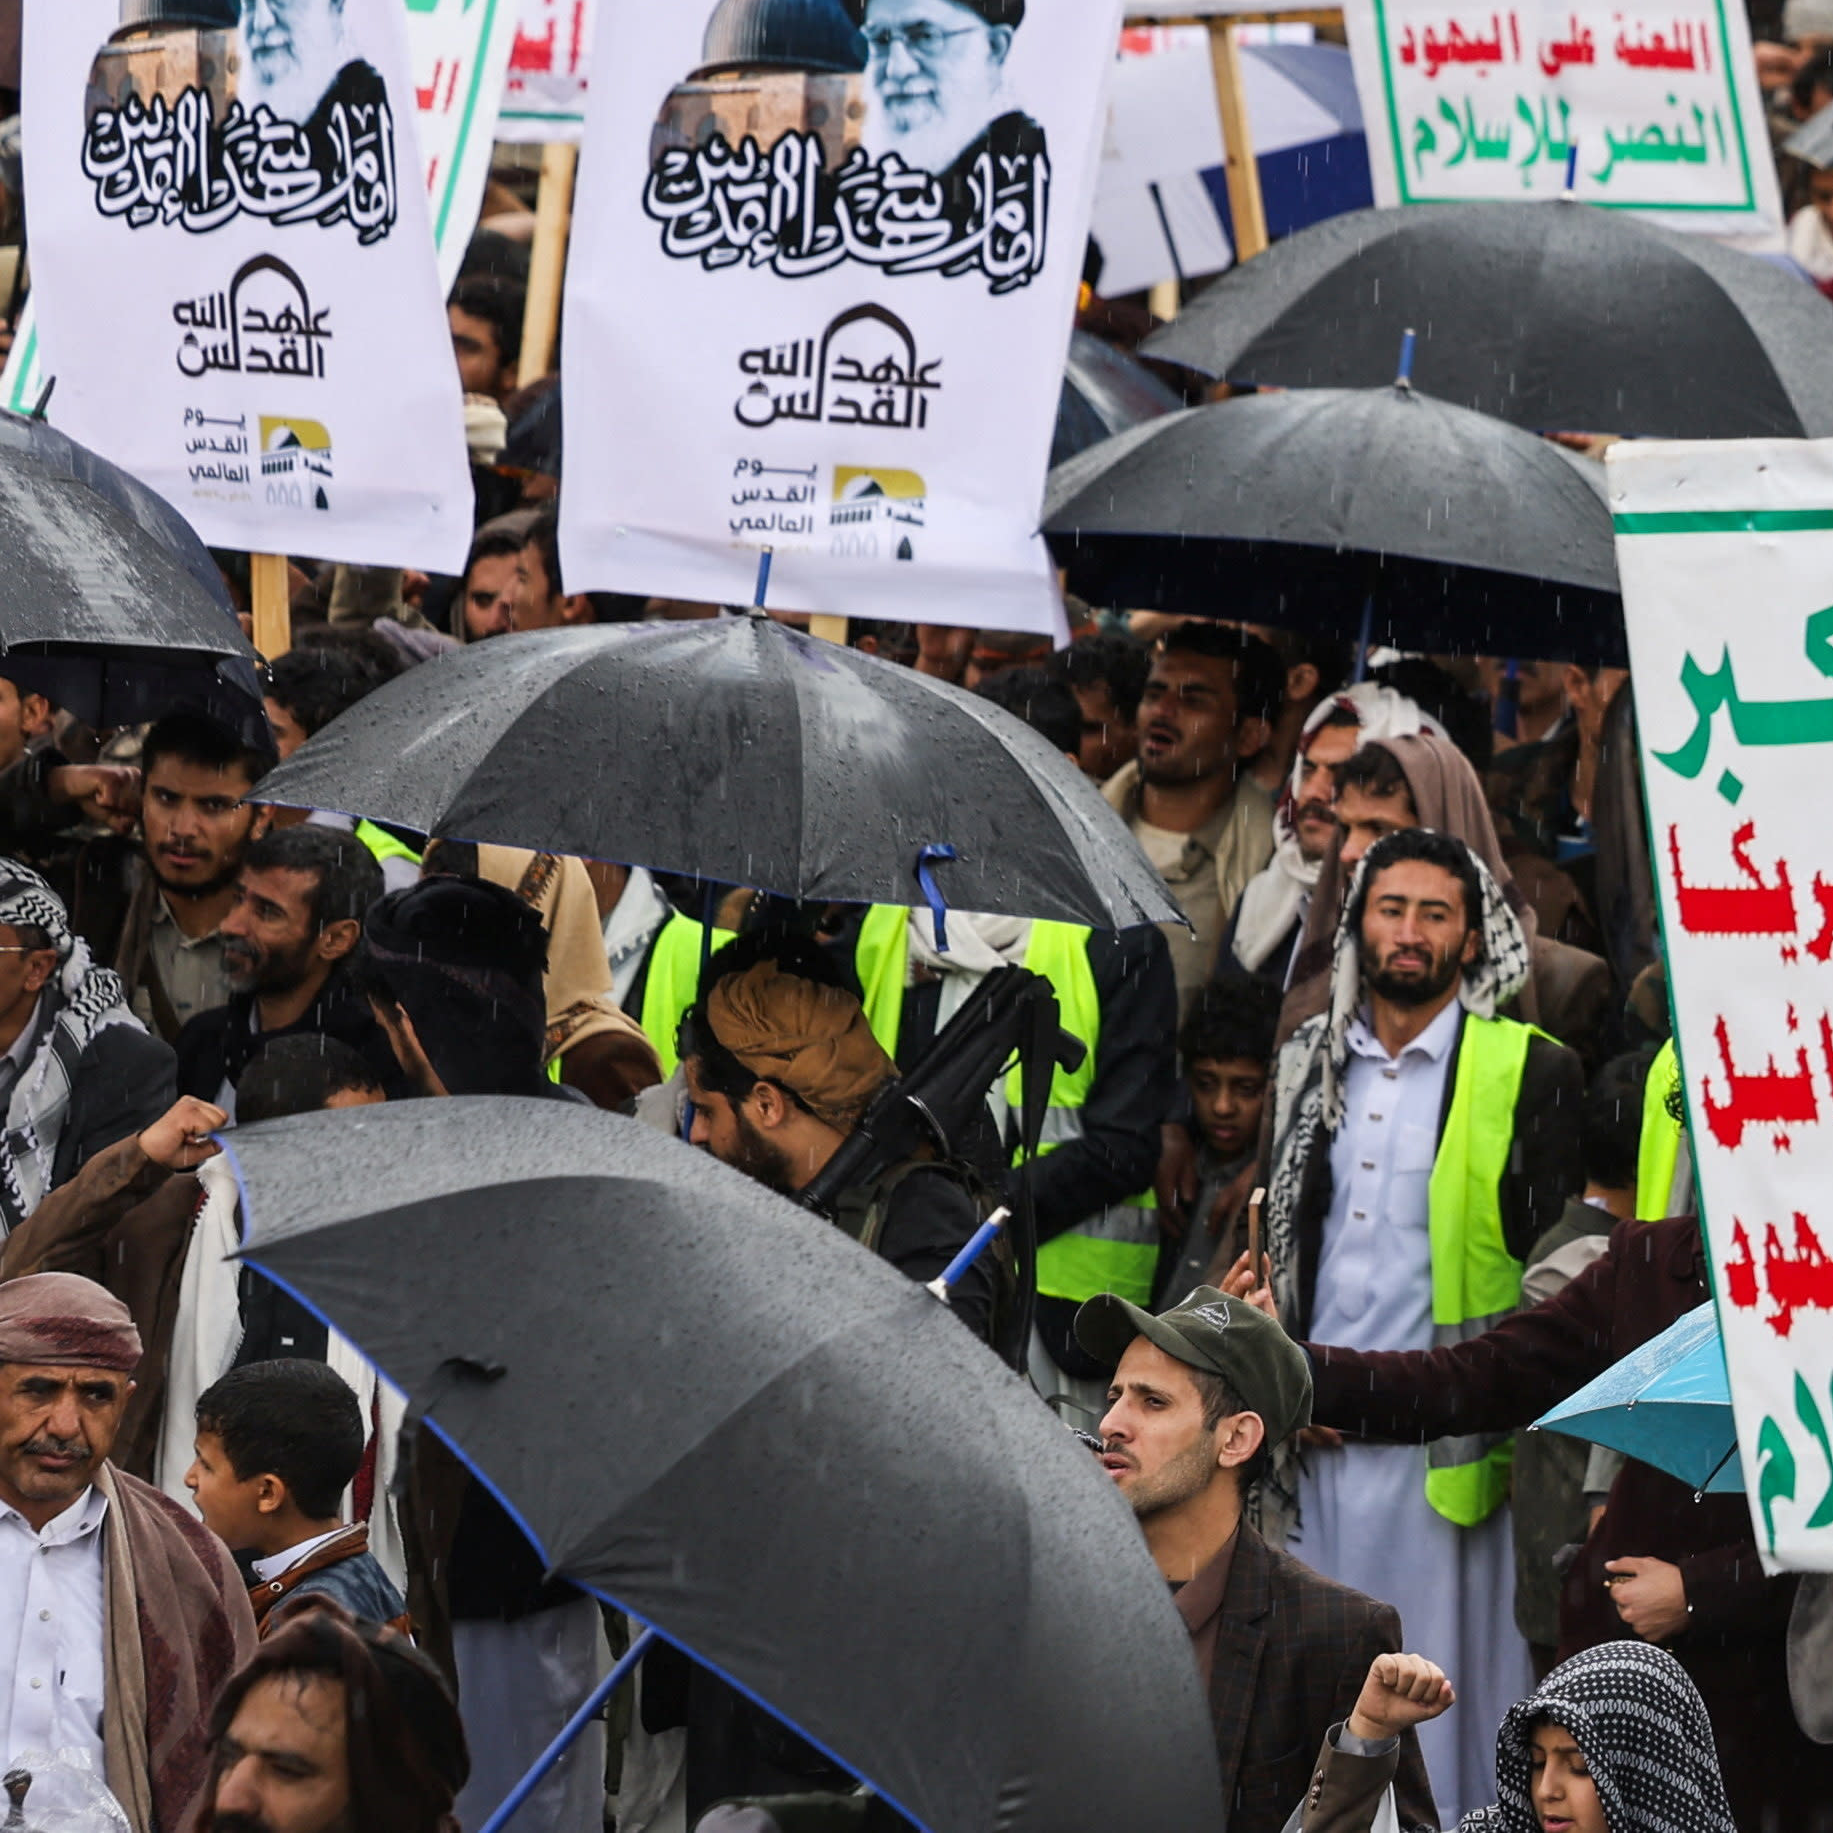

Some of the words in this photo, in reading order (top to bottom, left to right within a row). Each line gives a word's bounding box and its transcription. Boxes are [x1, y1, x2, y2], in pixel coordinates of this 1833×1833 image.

[1397, 11, 1523, 81] اليهود
[1537, 14, 1599, 80] على
[1613, 14, 1712, 73] اللعنة
[1413, 94, 1576, 190] للإسلام
[1591, 94, 1727, 186] النصر
[173, 292, 227, 331] الله
[242, 305, 332, 337] عهد
[177, 331, 324, 378] القدس
[739, 338, 814, 377] الله
[831, 354, 943, 389] عهد
[183, 407, 246, 430] يوم
[734, 381, 928, 429] القدس
[185, 436, 248, 454] القدس
[188, 463, 250, 484] العالمي
[733, 457, 817, 478] يوم
[732, 485, 815, 504] القدس
[729, 513, 813, 535] العالمي
